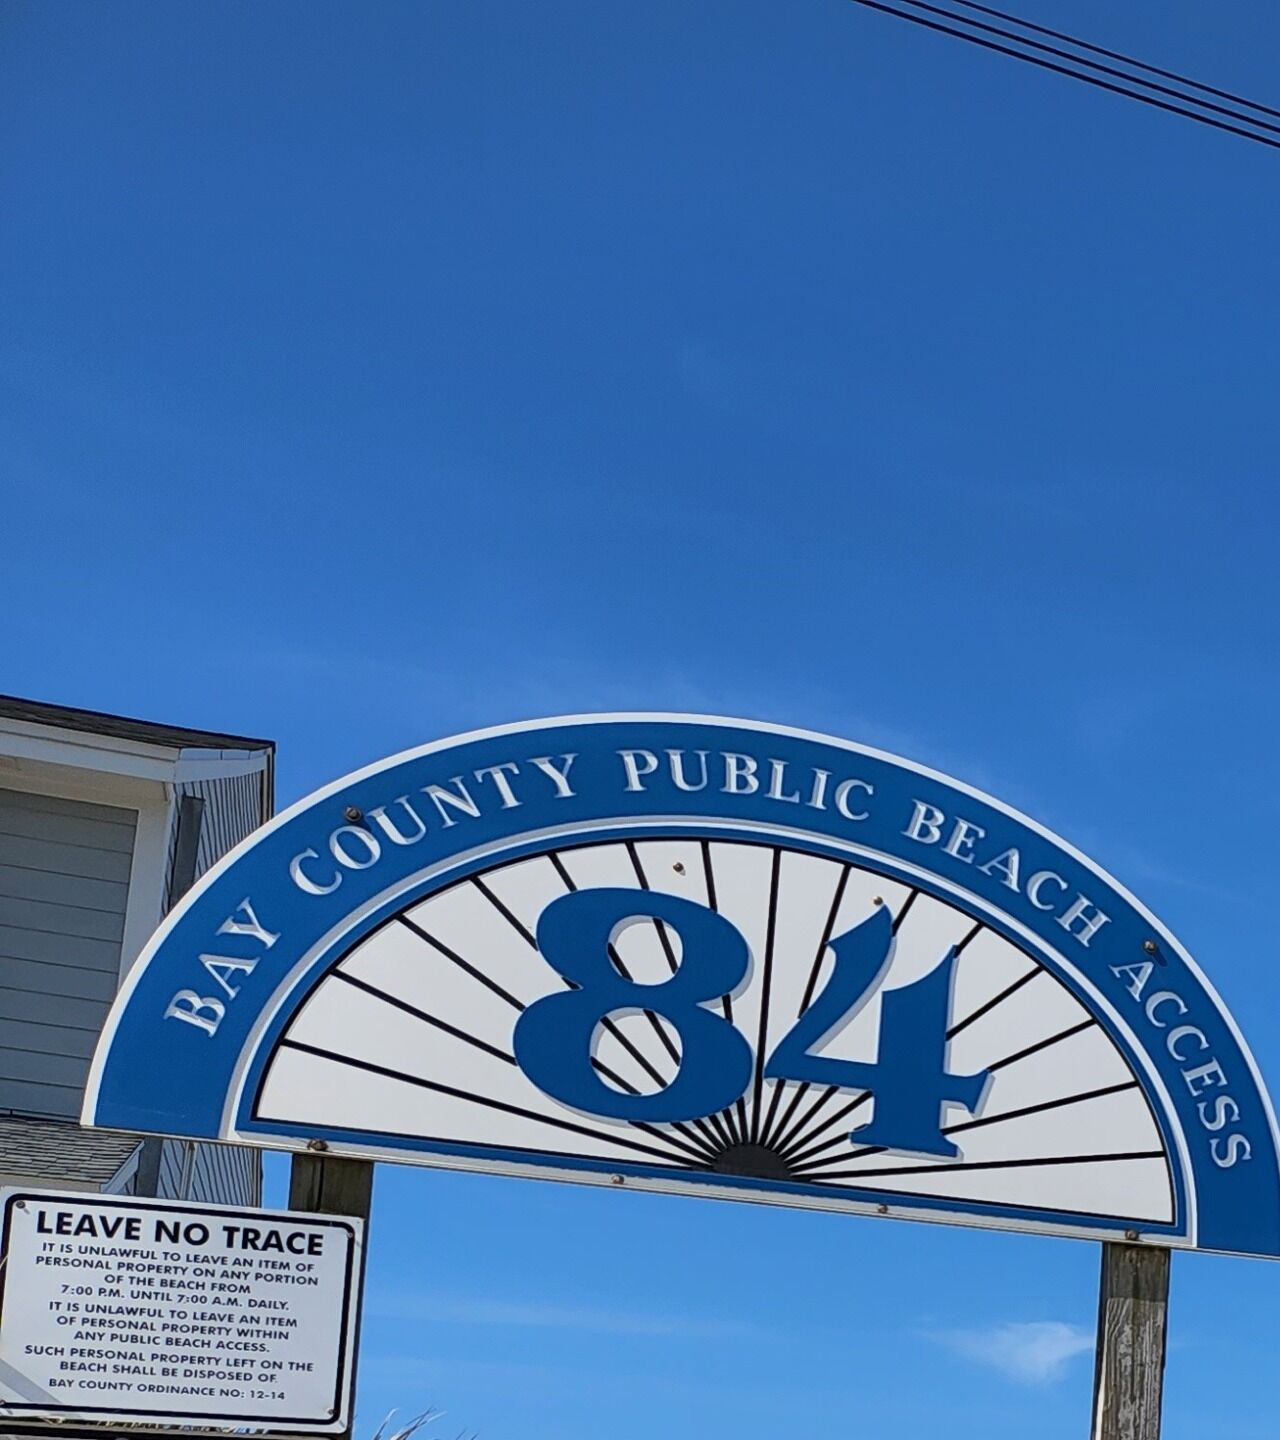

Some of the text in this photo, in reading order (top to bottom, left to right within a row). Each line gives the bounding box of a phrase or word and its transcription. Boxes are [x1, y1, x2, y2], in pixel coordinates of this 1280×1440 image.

[162, 748, 1253, 1169] BAY COUNTY PUBLIC BEACH ACCESS
[512, 886, 995, 1159] 84
[36, 1211, 324, 1256] LEAVE NO TRACE
[42, 1242, 315, 1272] IT IS UNLAWFUL TO LEAVE AN ITEM OF
[36, 1256, 318, 1286] PERSONAL PROPERTY ON ANY PORTION
[104, 1274, 251, 1294] OF THE BEACH FROM
[61, 1285, 289, 1311] 7:00 P.M. UNTIL 7:00 A.M. DAILY.
[49, 1302, 298, 1327] IT IS UNLAWFUL TO LEAVE AN ITEM
[57, 1316, 289, 1340] OF PERSONAL PROPERTY WITHIN
[74, 1331, 270, 1353] ANY PUBLIC BEACH ACCESS.
[25, 1345, 314, 1372] SUCH PERSONAL PROPERTY LEFT ON THE
[60, 1361, 107, 1373] BEACH
[113, 1364, 156, 1376] SHALL
[162, 1367, 178, 1377] BE
[183, 1369, 252, 1381] DISPOSED
[49, 1379, 285, 1400] BAY COUNTY ORDINANCE NO: 12-14
